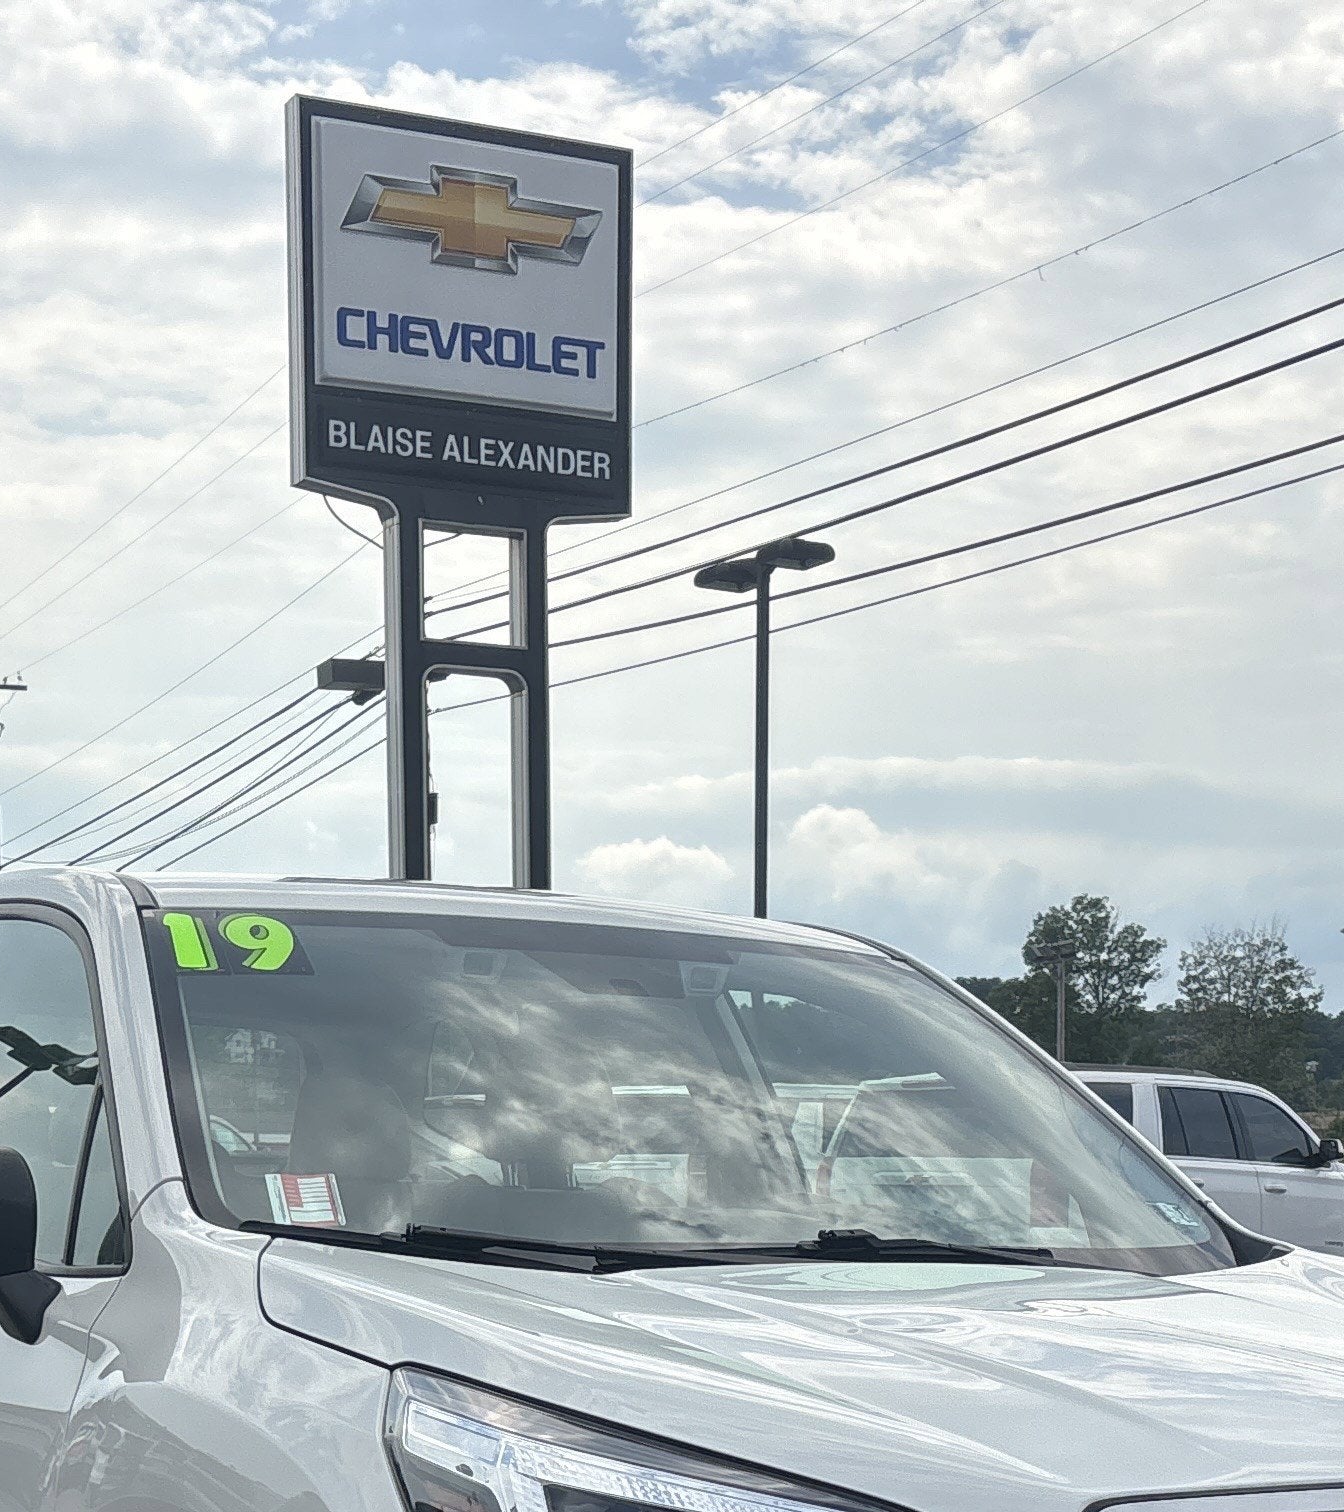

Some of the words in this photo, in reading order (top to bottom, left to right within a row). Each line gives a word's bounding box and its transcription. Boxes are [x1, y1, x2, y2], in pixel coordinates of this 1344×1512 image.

[336, 306, 606, 379] CHEVROLET
[327, 418, 433, 460] BLAISE
[442, 433, 612, 481] ALEXANDER
[162, 911, 295, 972] 19
